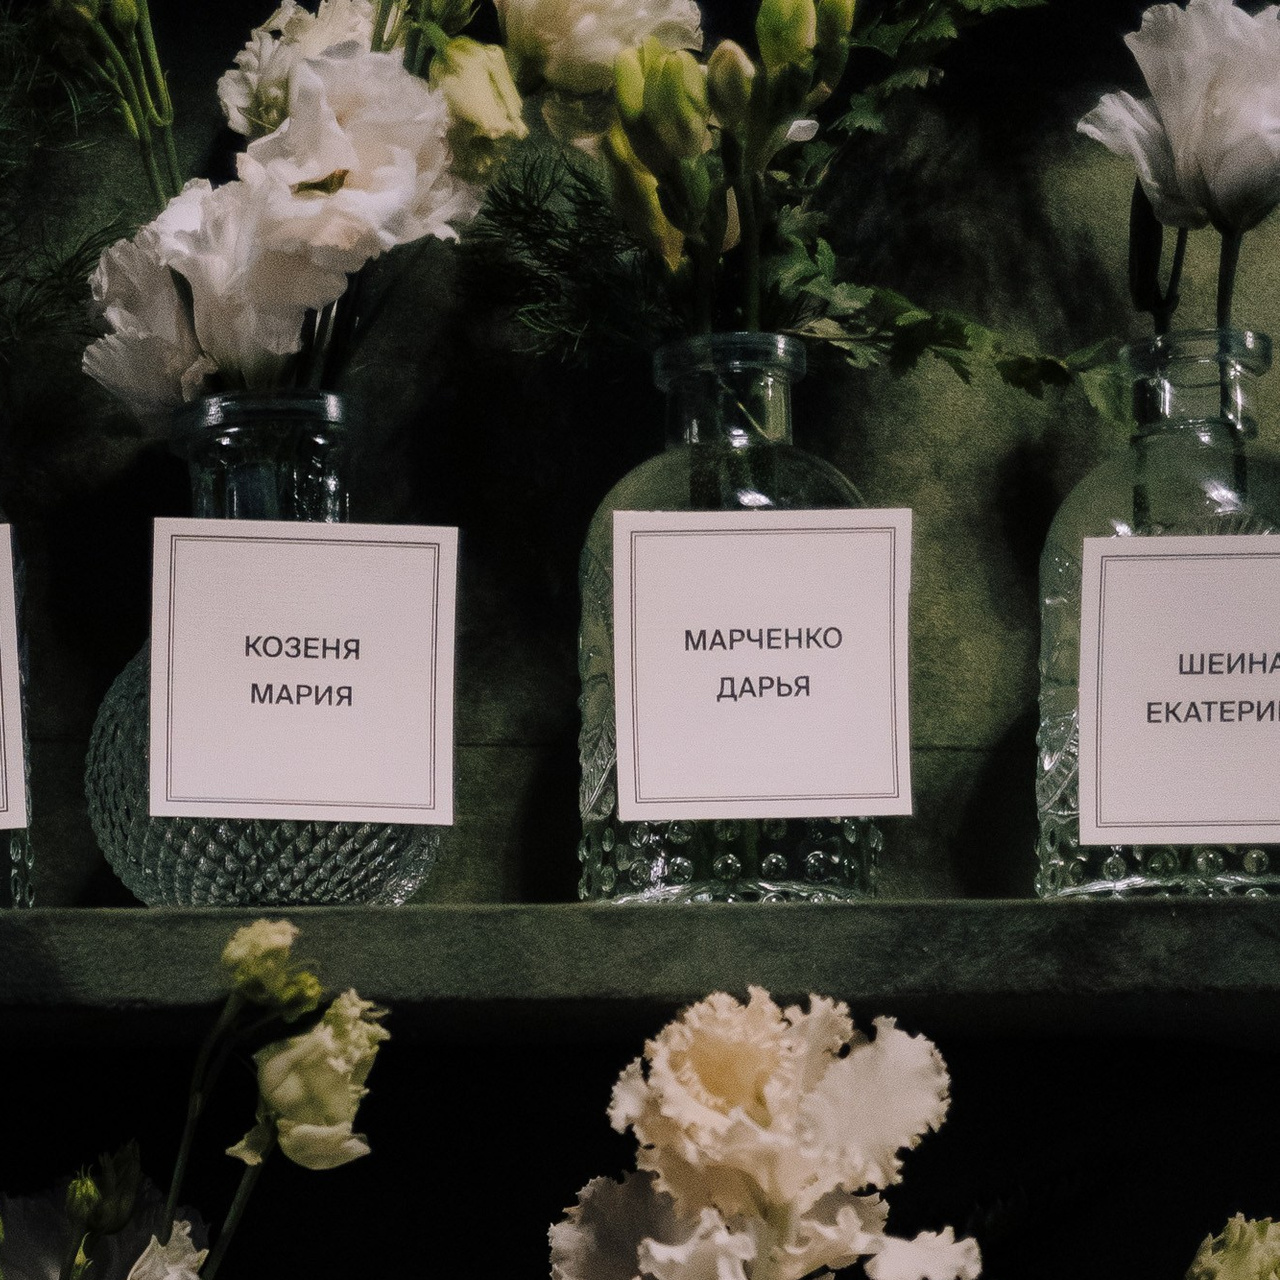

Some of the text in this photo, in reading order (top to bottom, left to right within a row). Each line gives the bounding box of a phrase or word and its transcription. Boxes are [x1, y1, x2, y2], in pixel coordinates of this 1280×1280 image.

[245, 635, 360, 660] КОЗЕНЯ
[684, 626, 843, 651] МАРЧЕНКО
[1178, 652, 1280, 676] ШЕИНА
[250, 682, 353, 707] МАРИЯ
[716, 675, 810, 703] ДАРЬЯ
[1146, 700, 1280, 724] ЕКАТЕРИ
